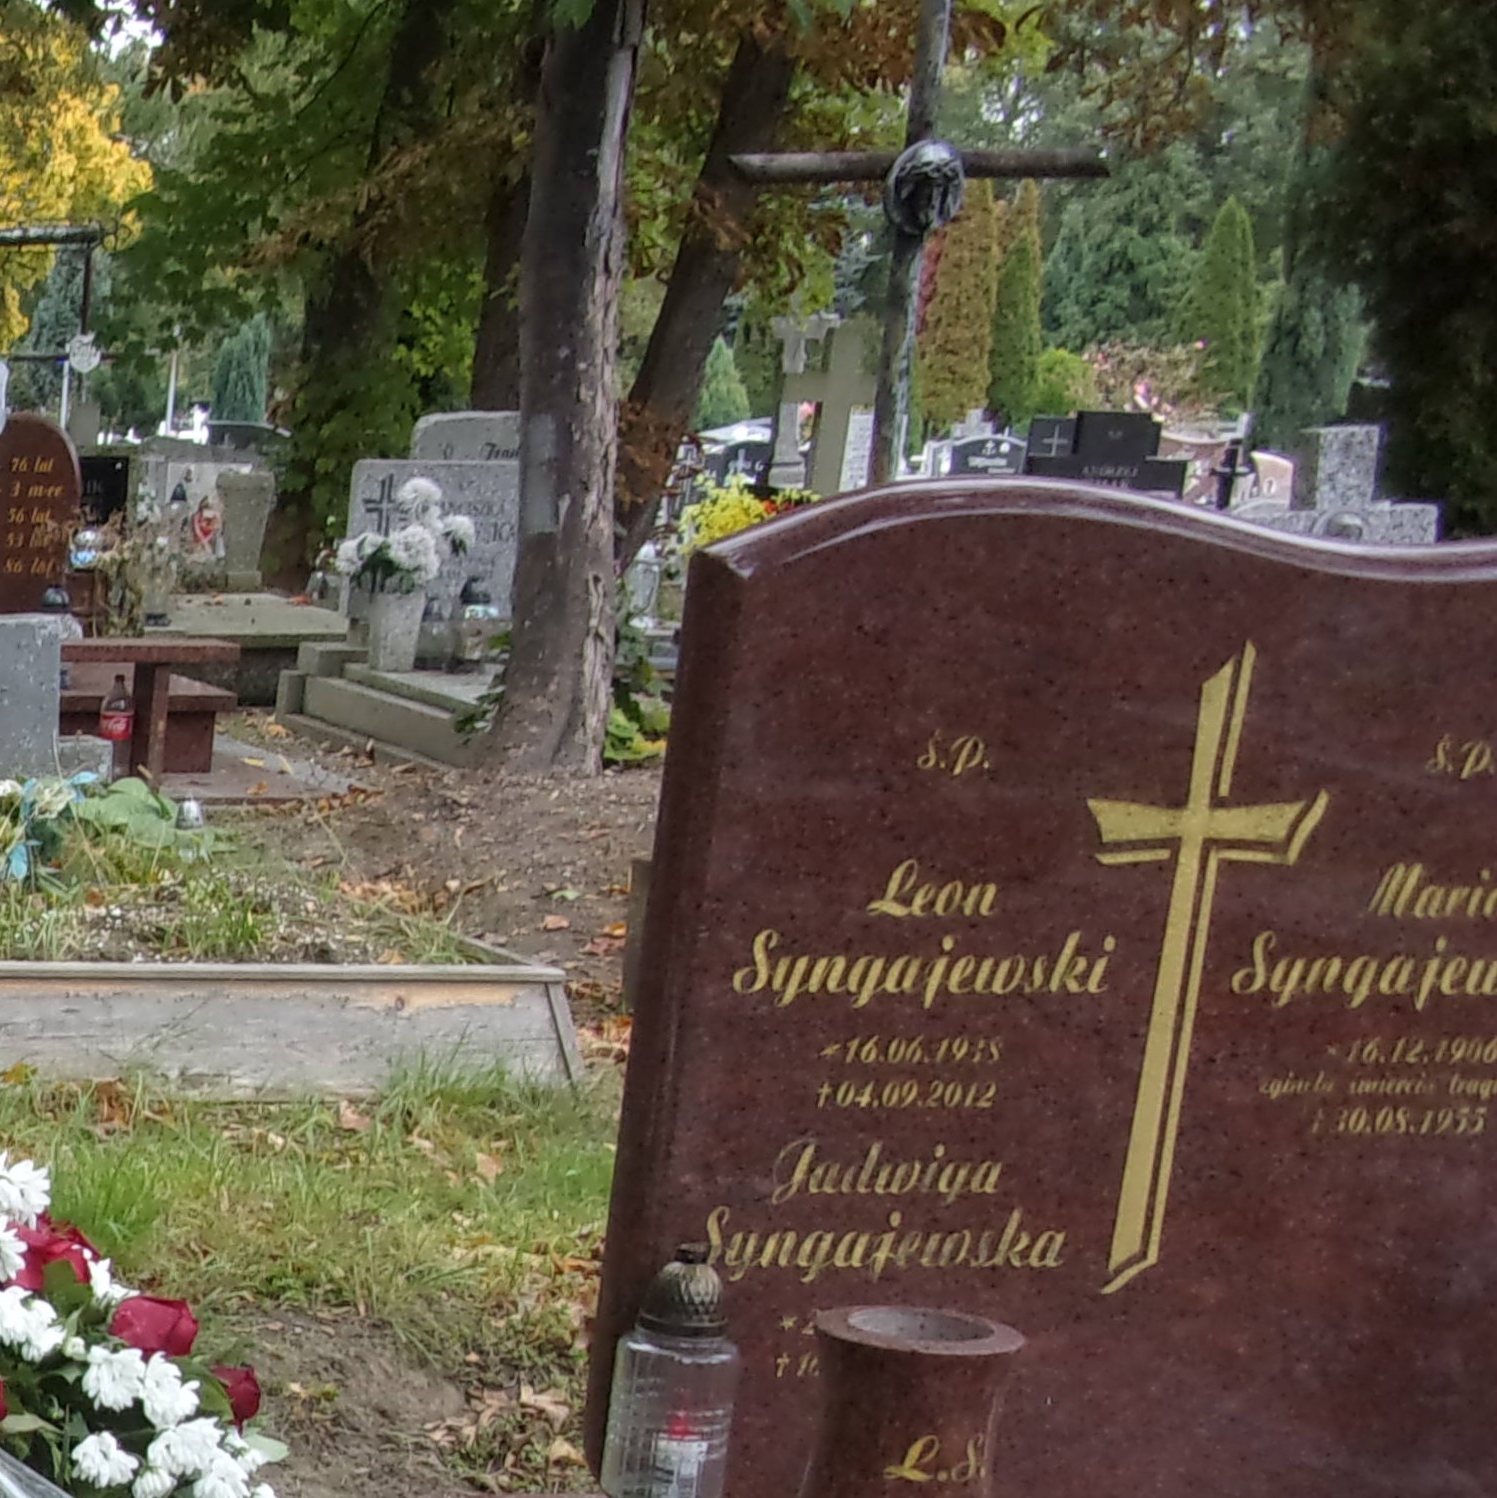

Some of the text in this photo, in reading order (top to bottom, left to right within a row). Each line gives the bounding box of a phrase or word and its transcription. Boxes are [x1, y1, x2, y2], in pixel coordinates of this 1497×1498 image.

[34, 456, 55, 473] lat
[866, 858, 998, 918] Leon
[732, 928, 1117, 1009] Syngajewski
[772, 1138, 1003, 1205] Jadwiga
[705, 1204, 1066, 1282] Syngajewska
